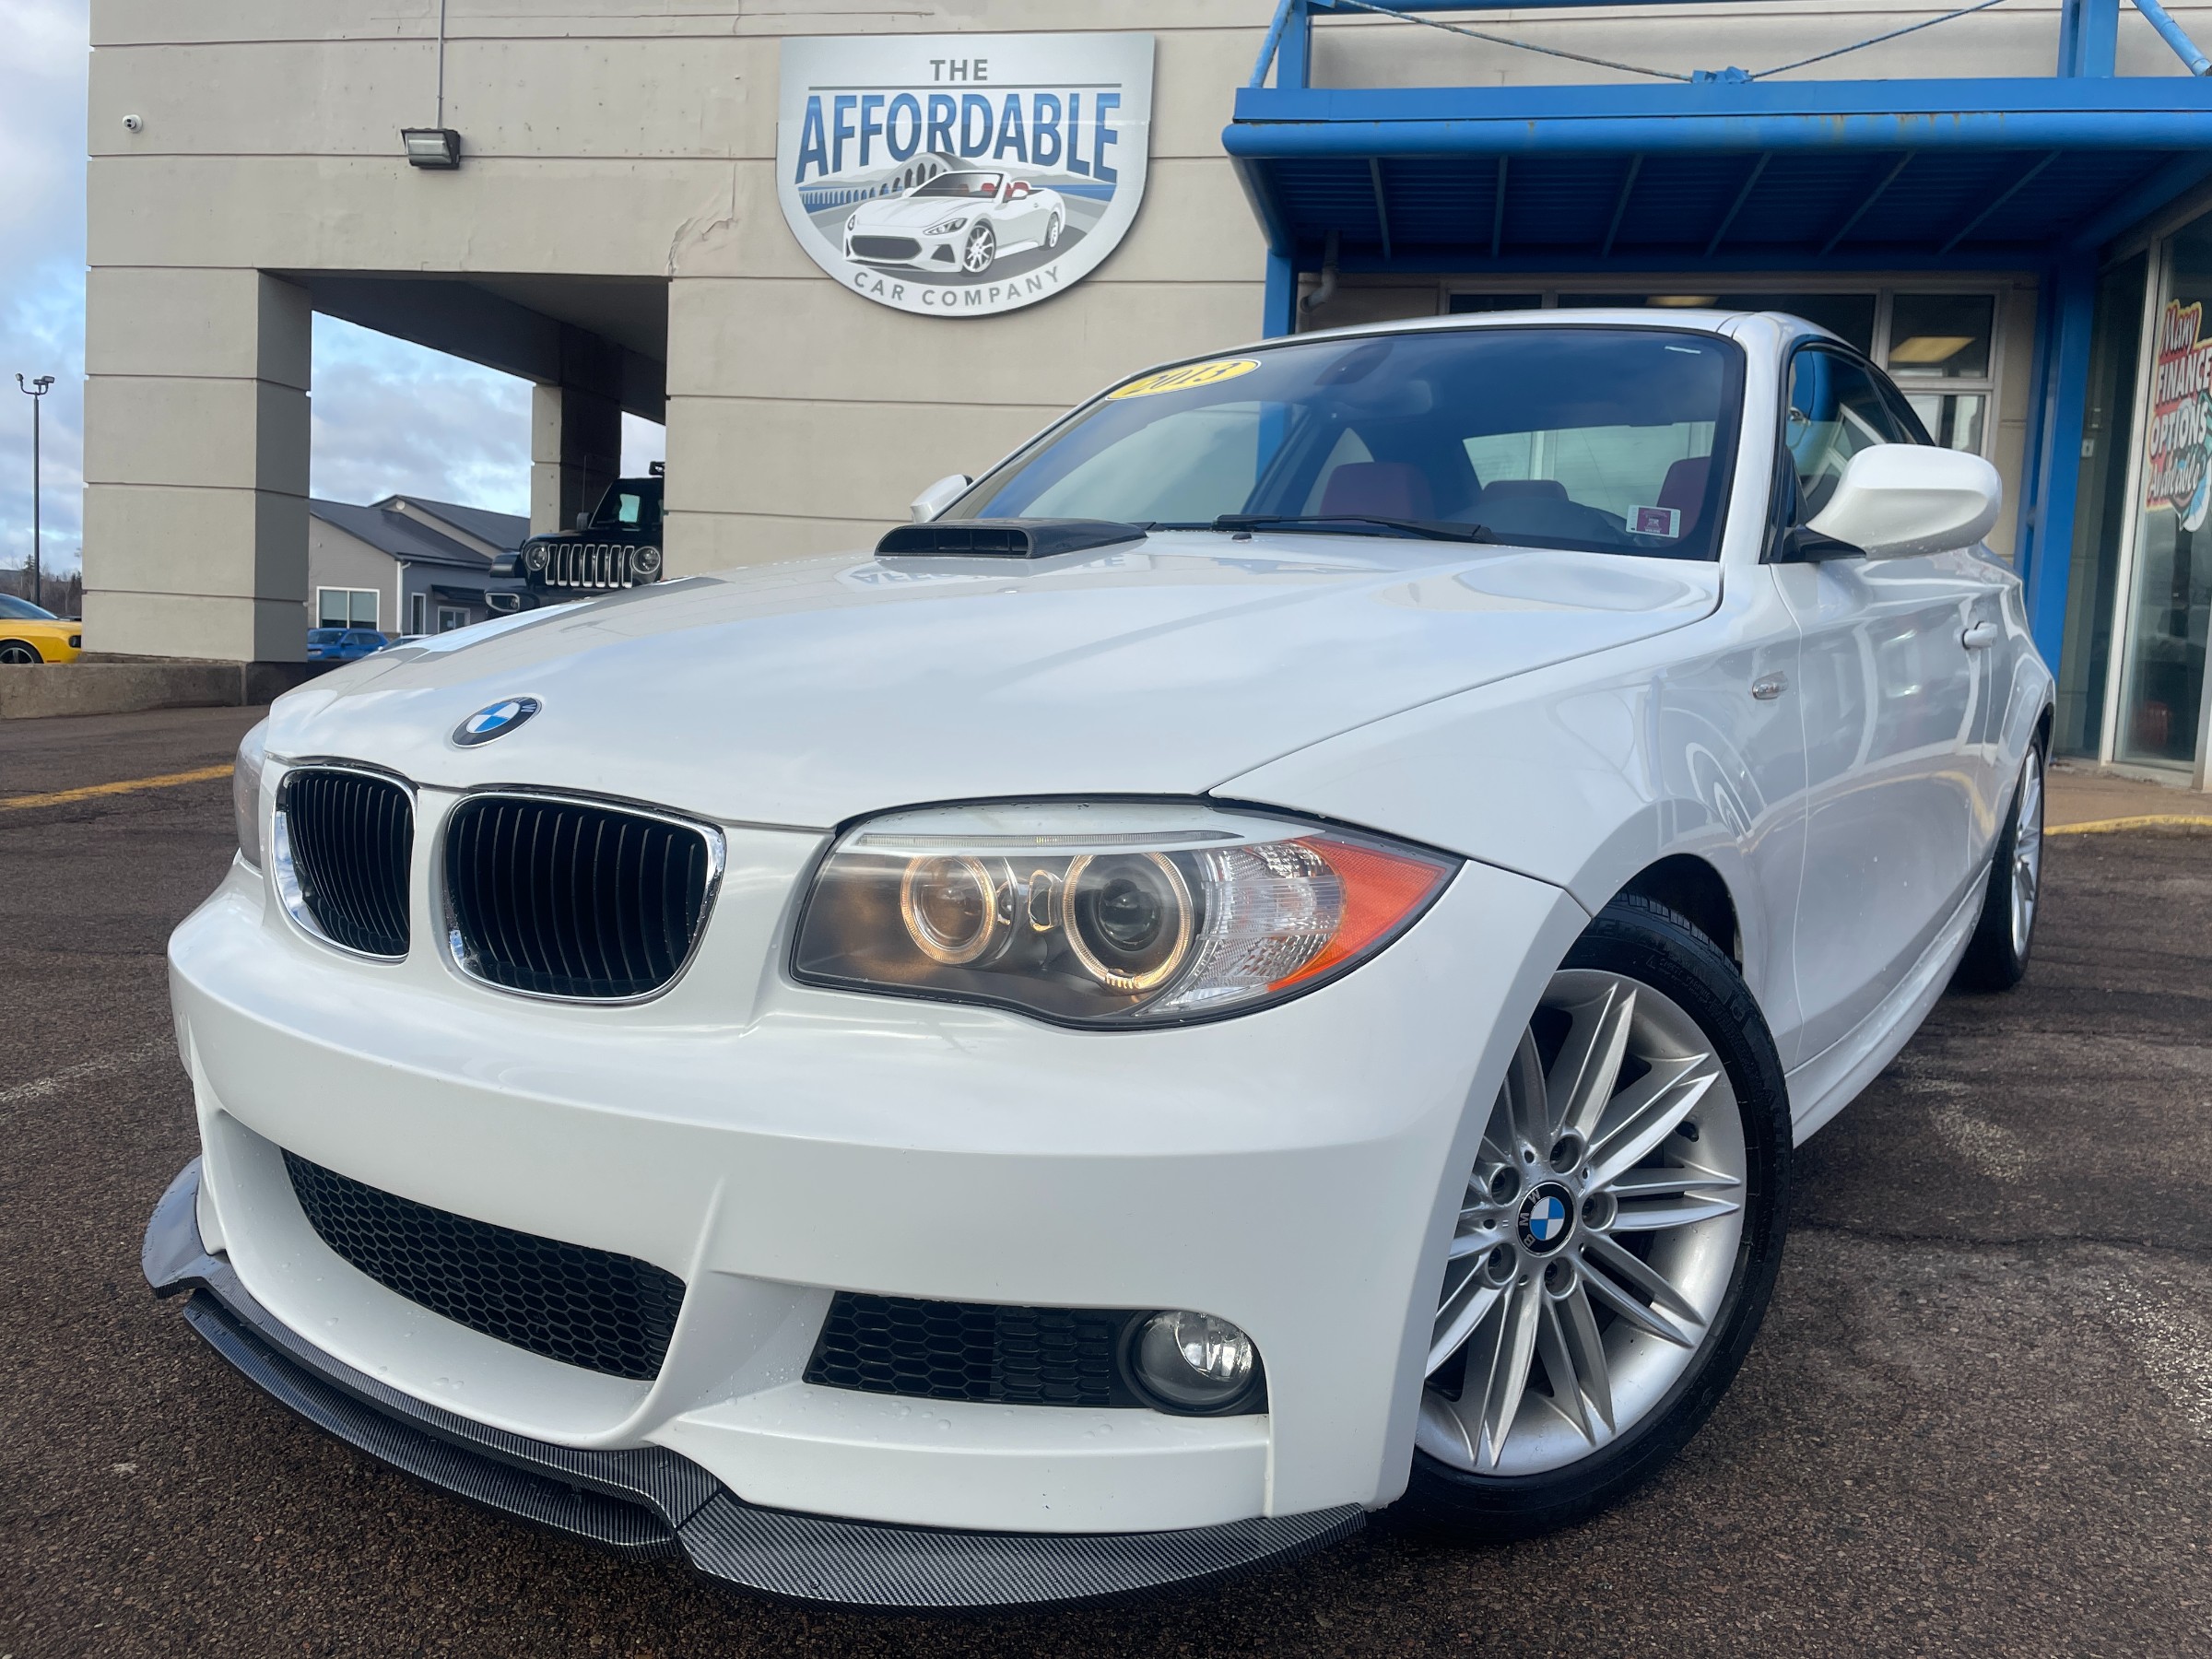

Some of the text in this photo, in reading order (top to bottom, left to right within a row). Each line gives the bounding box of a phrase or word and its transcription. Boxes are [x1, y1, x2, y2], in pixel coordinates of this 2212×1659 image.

[929, 58, 989, 82] THE
[794, 92, 1122, 185] AFFORDABLE
[853, 265, 1062, 307] CAR COMPANY
[2159, 307, 2198, 357] Many
[1121, 361, 1242, 396] 2013
[2156, 346, 2212, 406] FINANCE
[2149, 401, 2209, 457] OPTIONS
[1519, 1188, 1542, 1248] BMW
